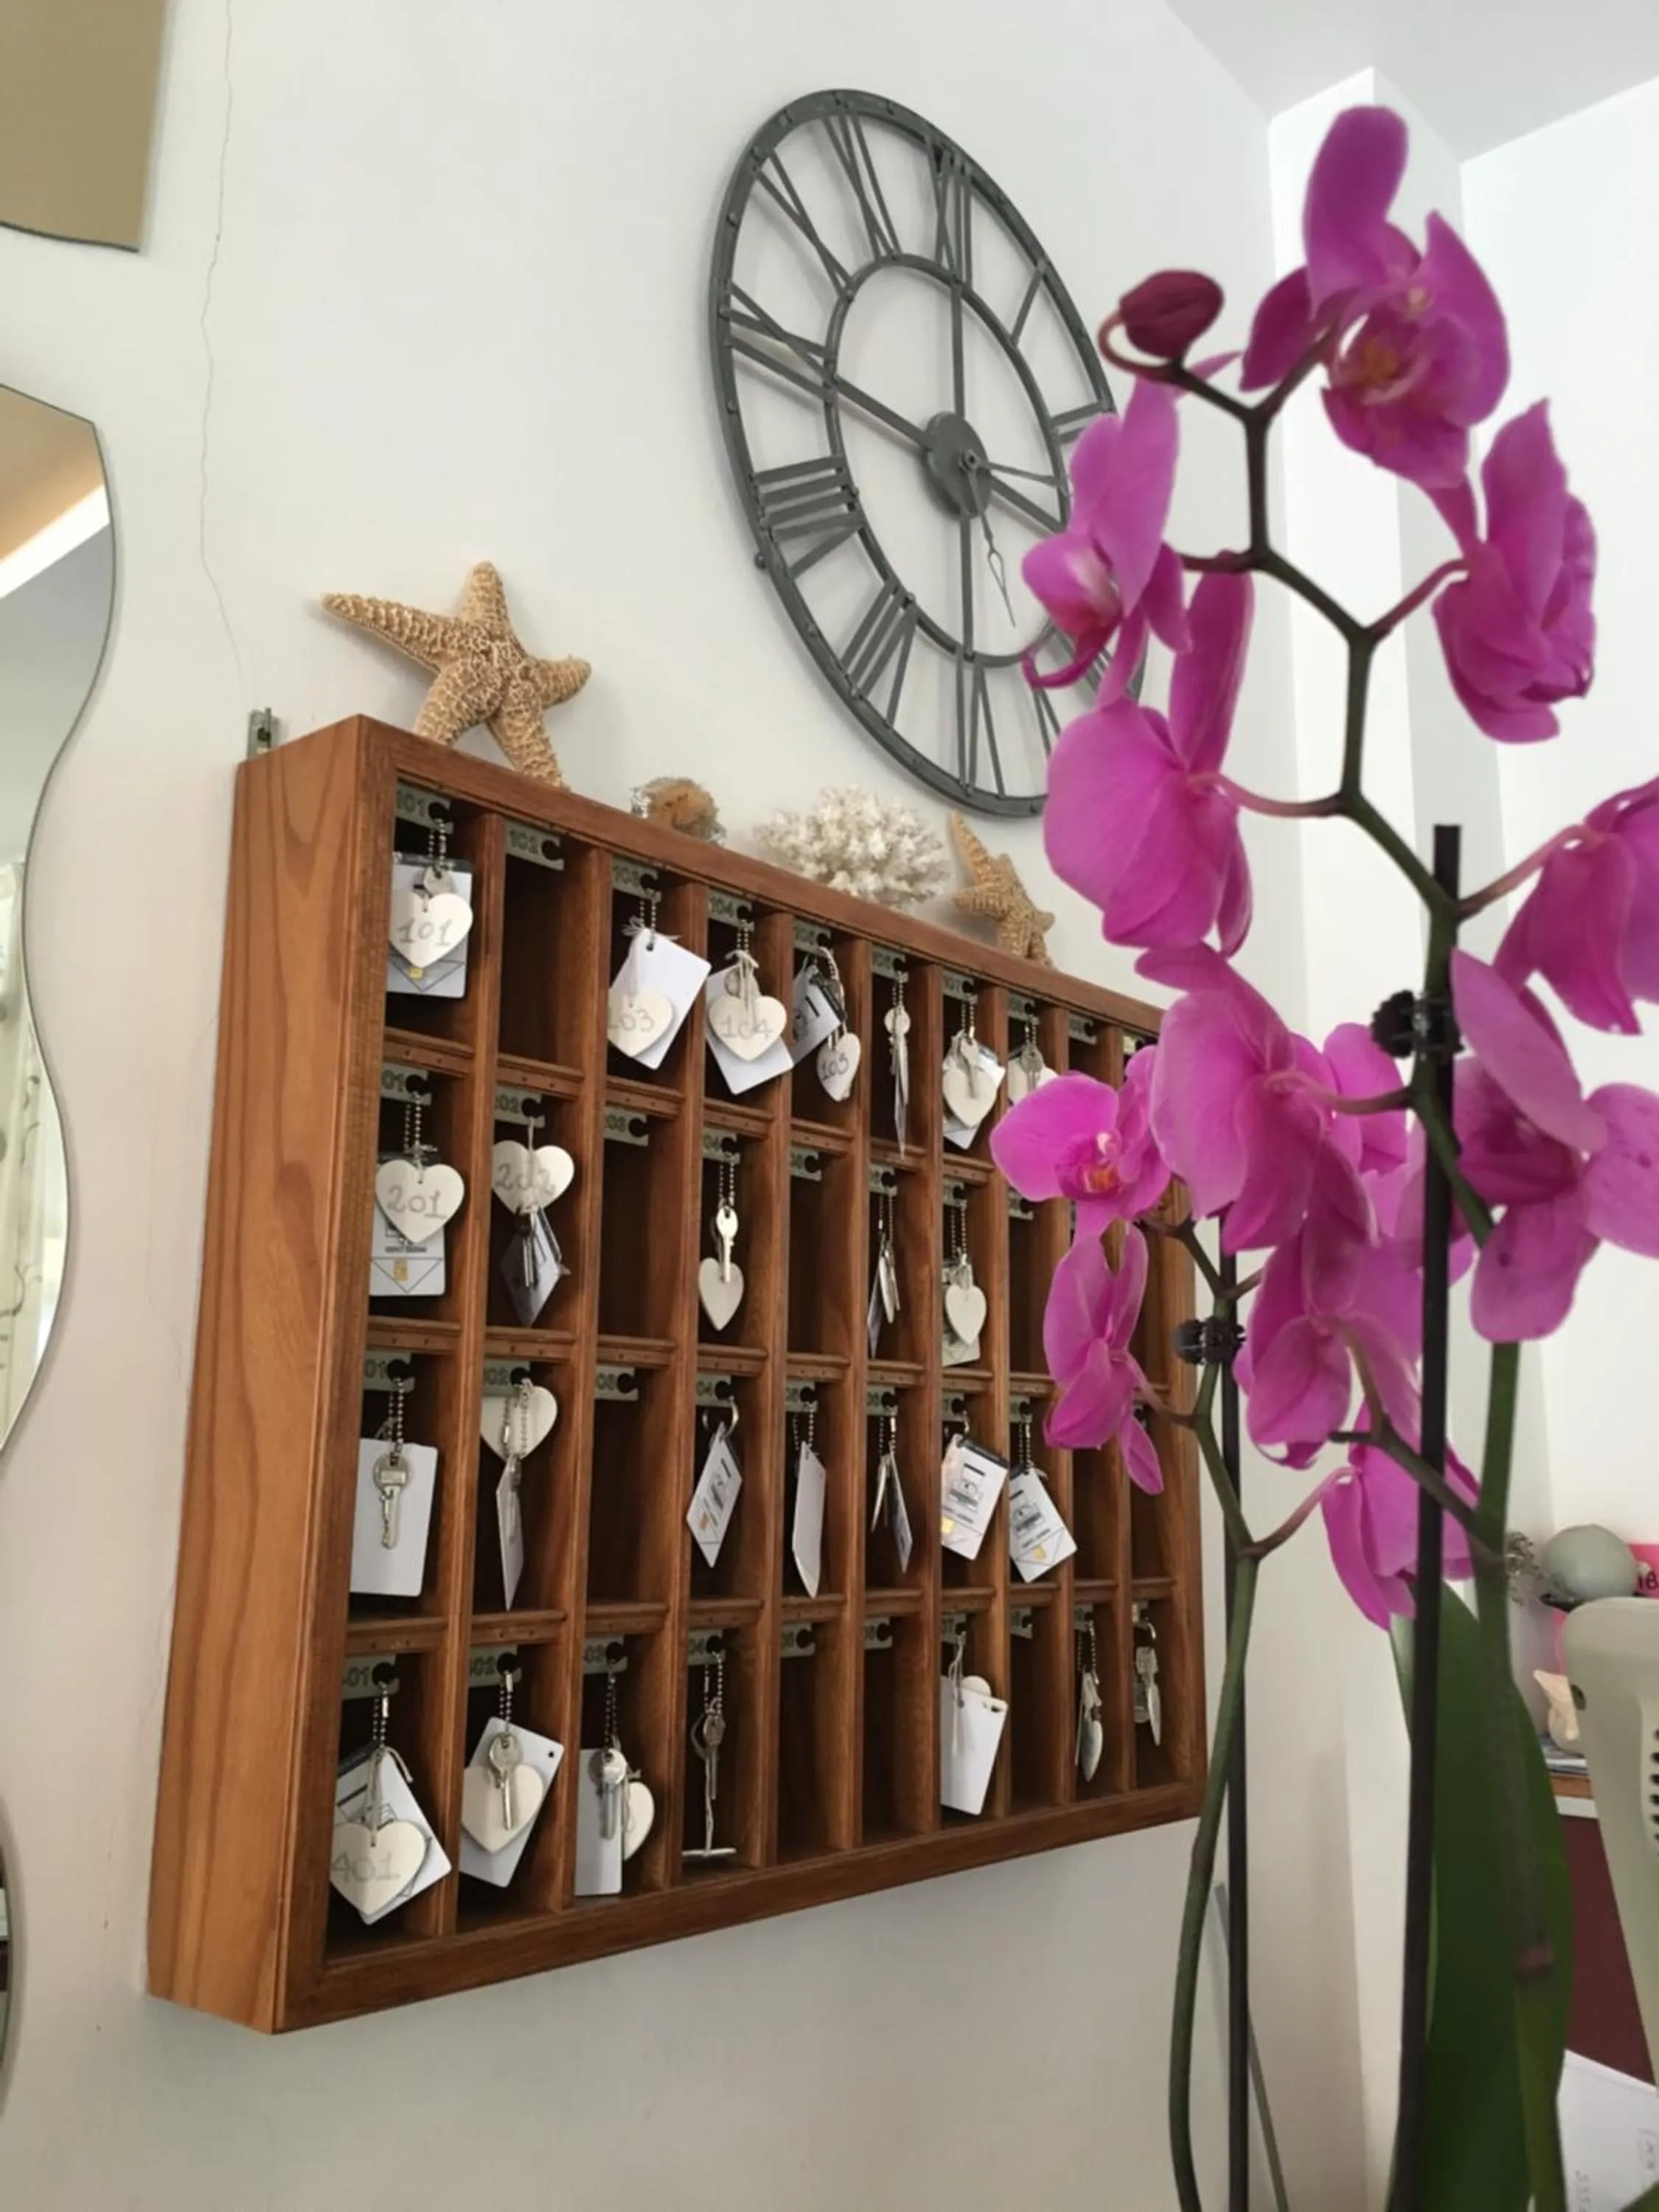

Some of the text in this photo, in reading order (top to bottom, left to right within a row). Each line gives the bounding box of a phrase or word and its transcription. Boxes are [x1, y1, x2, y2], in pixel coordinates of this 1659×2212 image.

[397, 918, 452, 946] 101
[821, 1054, 849, 1079] 105
[387, 1184, 448, 1219] 201
[333, 1851, 400, 1884] 401
